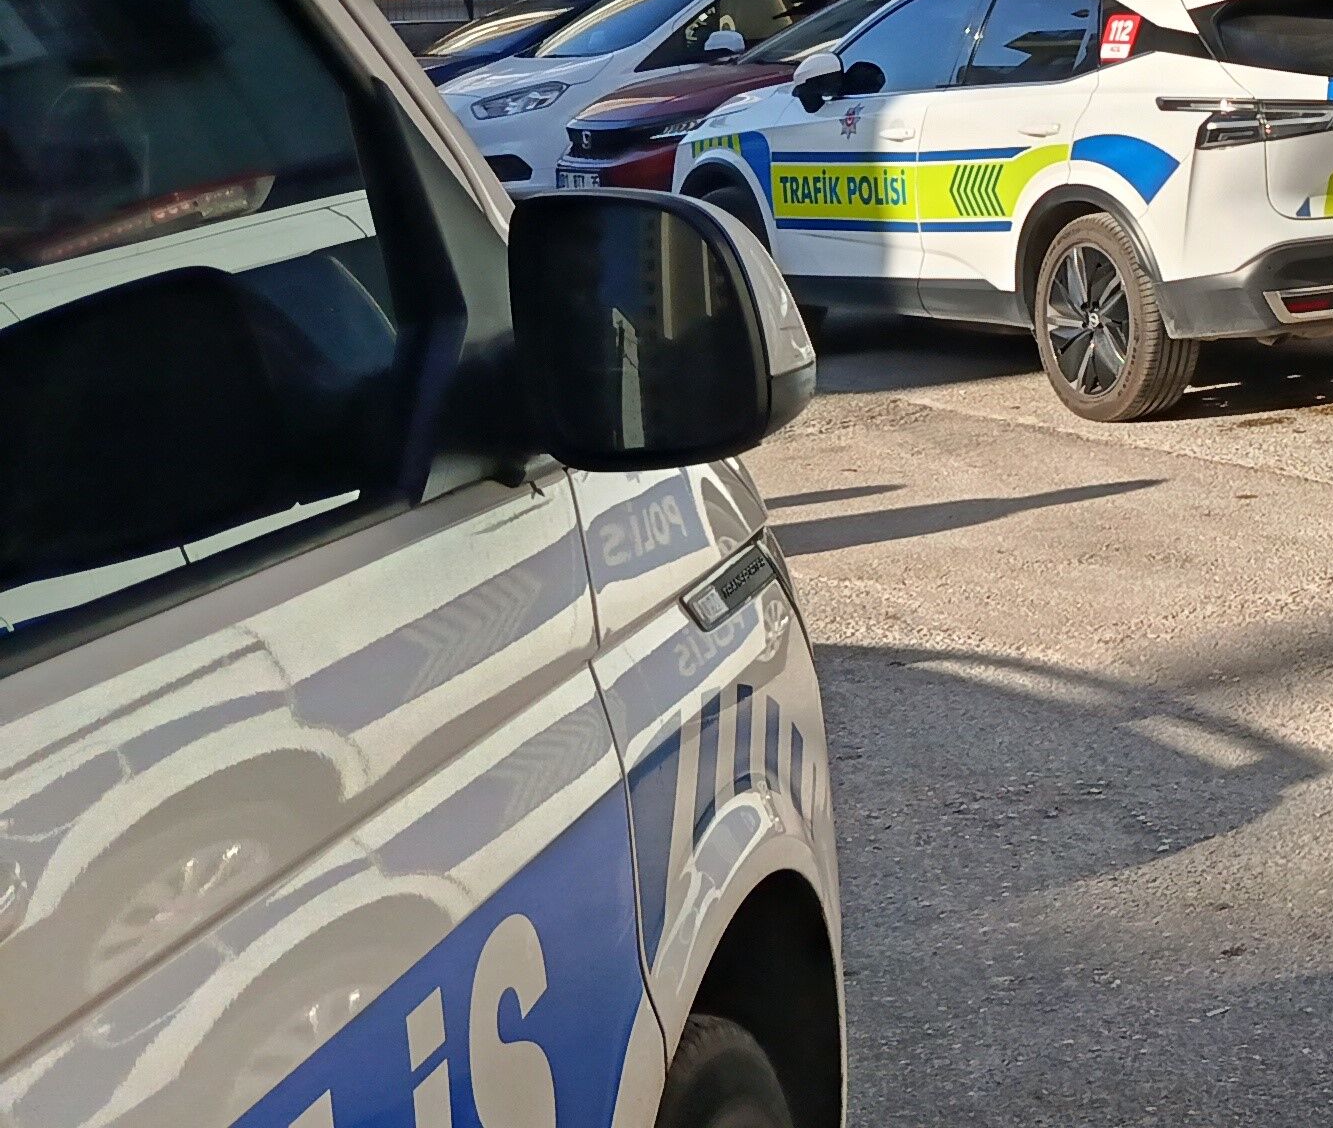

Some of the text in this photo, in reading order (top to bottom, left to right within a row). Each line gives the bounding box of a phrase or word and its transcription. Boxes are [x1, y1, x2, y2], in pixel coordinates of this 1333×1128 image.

[1108, 19, 1134, 41] 112
[780, 168, 907, 206] TRAFİK POLİSİ
